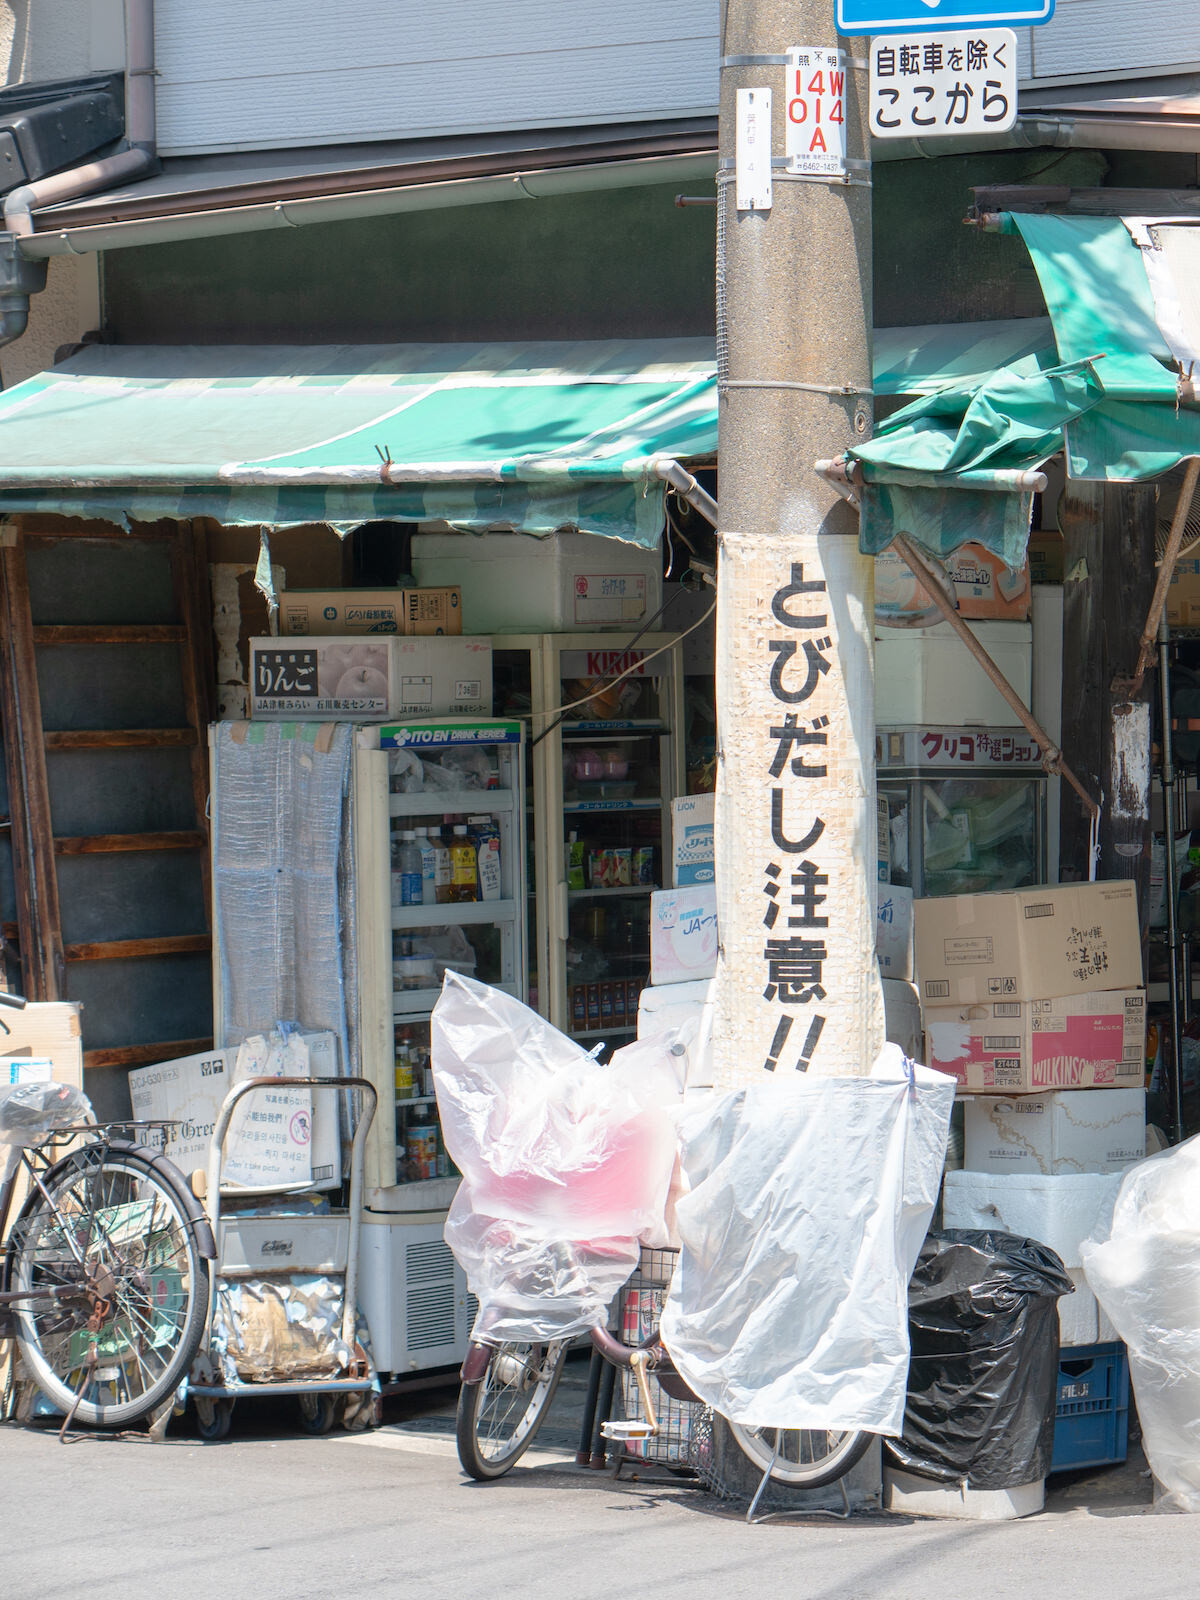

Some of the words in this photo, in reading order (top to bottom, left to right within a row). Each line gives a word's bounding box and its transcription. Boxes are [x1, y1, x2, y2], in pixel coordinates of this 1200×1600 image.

[876, 40, 1008, 77] 自転車を除く
[875, 80, 1009, 128] ここから
[809, 126, 827, 153] A
[587, 651, 645, 676] KIRIN
[259, 665, 315, 694] りんご
[677, 801, 696, 812] LION
